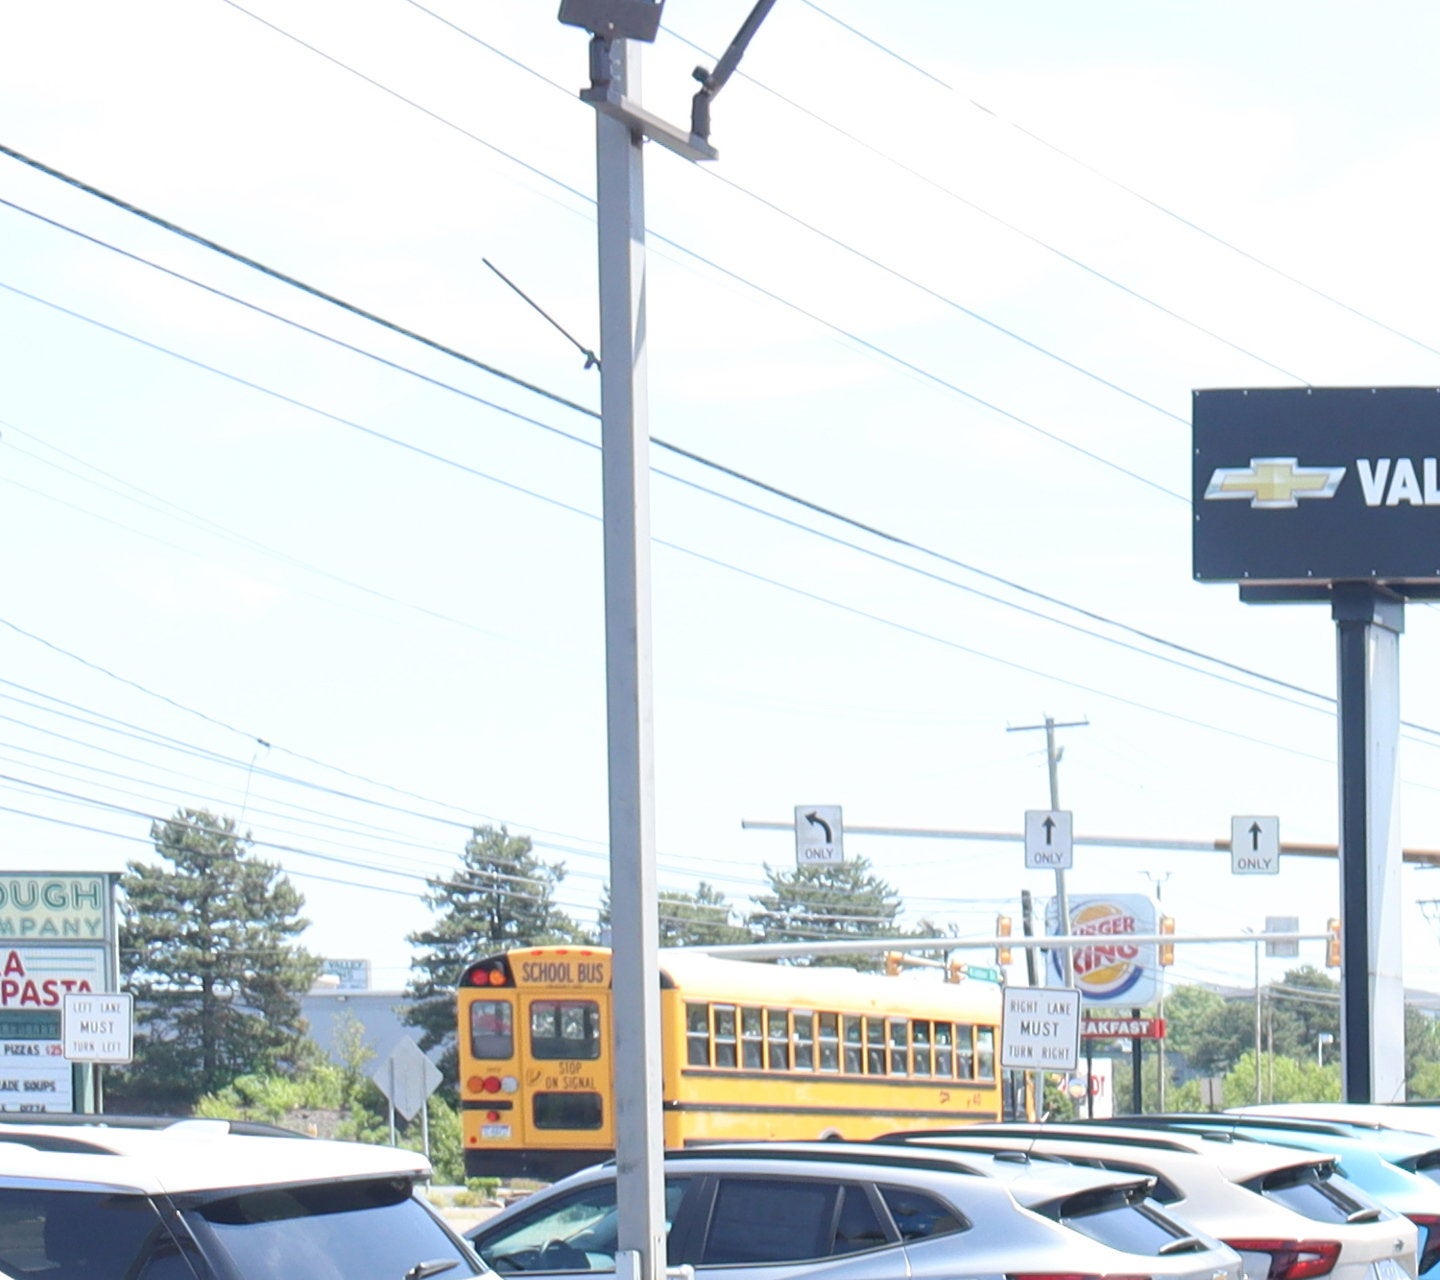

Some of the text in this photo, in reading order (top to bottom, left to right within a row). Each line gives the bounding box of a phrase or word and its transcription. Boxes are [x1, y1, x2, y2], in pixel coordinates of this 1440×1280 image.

[805, 848, 834, 860] ONLY
[1034, 852, 1063, 865] ONLY
[1238, 857, 1272, 870] ONLY
[1072, 916, 1136, 937] URGER
[522, 963, 604, 984] SCHOOL BUS
[73, 1003, 121, 1013] LEFT LANE
[1010, 1000, 1071, 1016] RIGHT LANE
[80, 1022, 114, 1034] MUST
[1020, 1022, 1060, 1037] MUST
[73, 1042, 121, 1052] TURN LEFT
[1009, 1045, 1070, 1060] TURN RIGHT
[559, 1062, 582, 1075] STOP
[546, 1076, 596, 1090] ON SIGNAL
